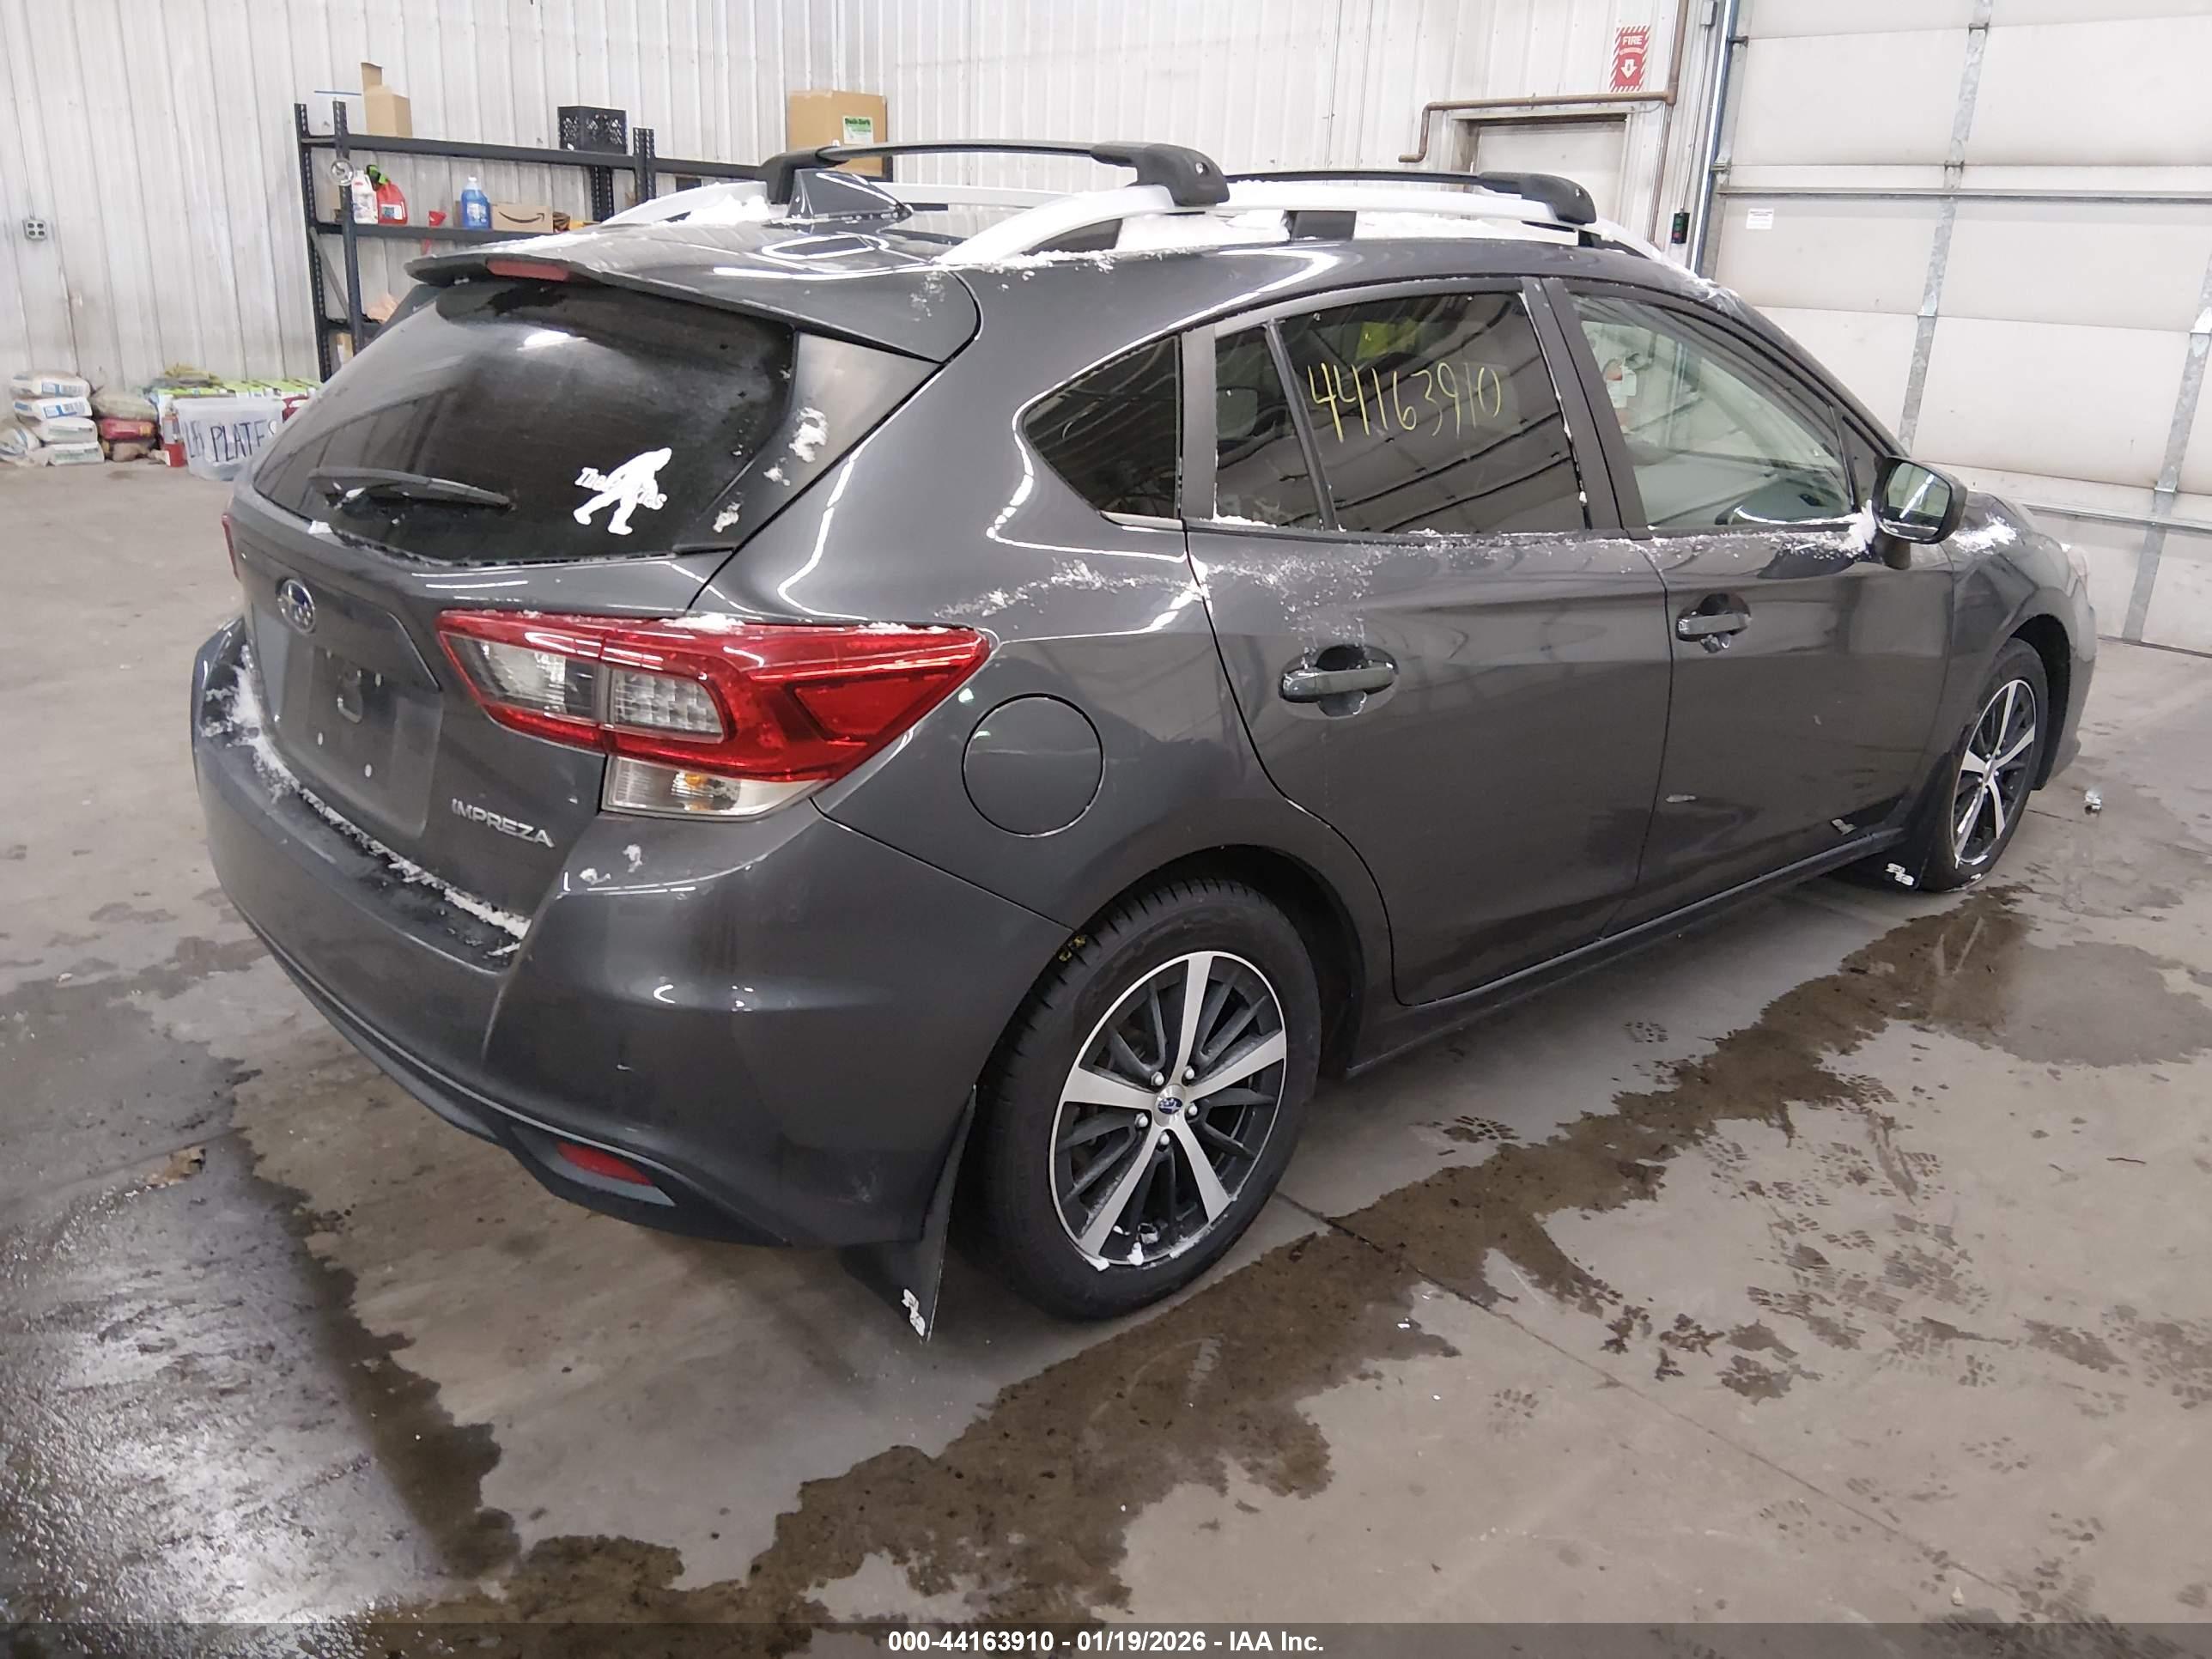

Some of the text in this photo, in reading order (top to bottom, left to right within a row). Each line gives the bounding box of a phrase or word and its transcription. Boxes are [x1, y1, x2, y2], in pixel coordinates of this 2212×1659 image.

[1622, 35, 1644, 46] FIRE
[1308, 362, 1501, 443] 44163910
[452, 798, 556, 848] IMPREZA
